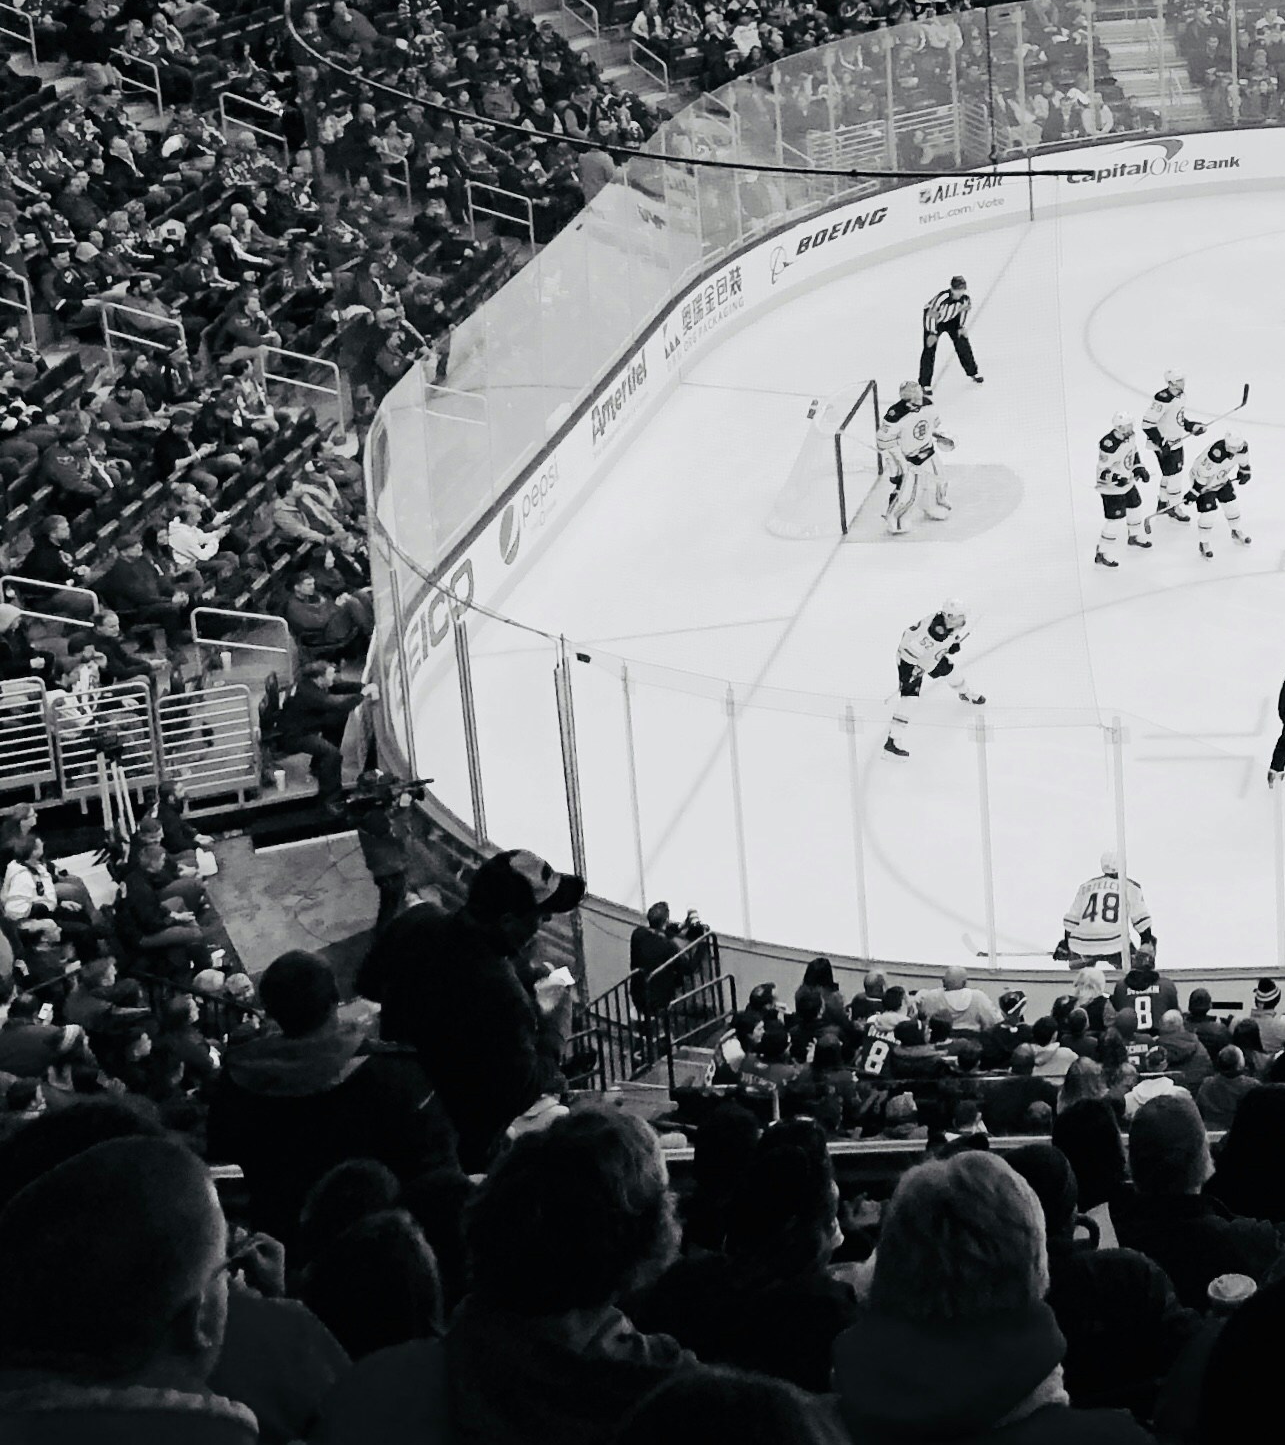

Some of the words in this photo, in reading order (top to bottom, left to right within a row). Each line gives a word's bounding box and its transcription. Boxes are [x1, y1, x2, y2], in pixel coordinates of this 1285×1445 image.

[1193, 156, 1240, 171] Bank
[932, 183, 959, 203] ALL
[919, 198, 1005, 224] NHL.com/Vote
[797, 207, 888, 255] BOEING
[521, 454, 559, 527] pepsi
[1081, 892, 1120, 924] 48
[1134, 995, 1154, 1030] 8
[864, 1040, 890, 1075] 8
